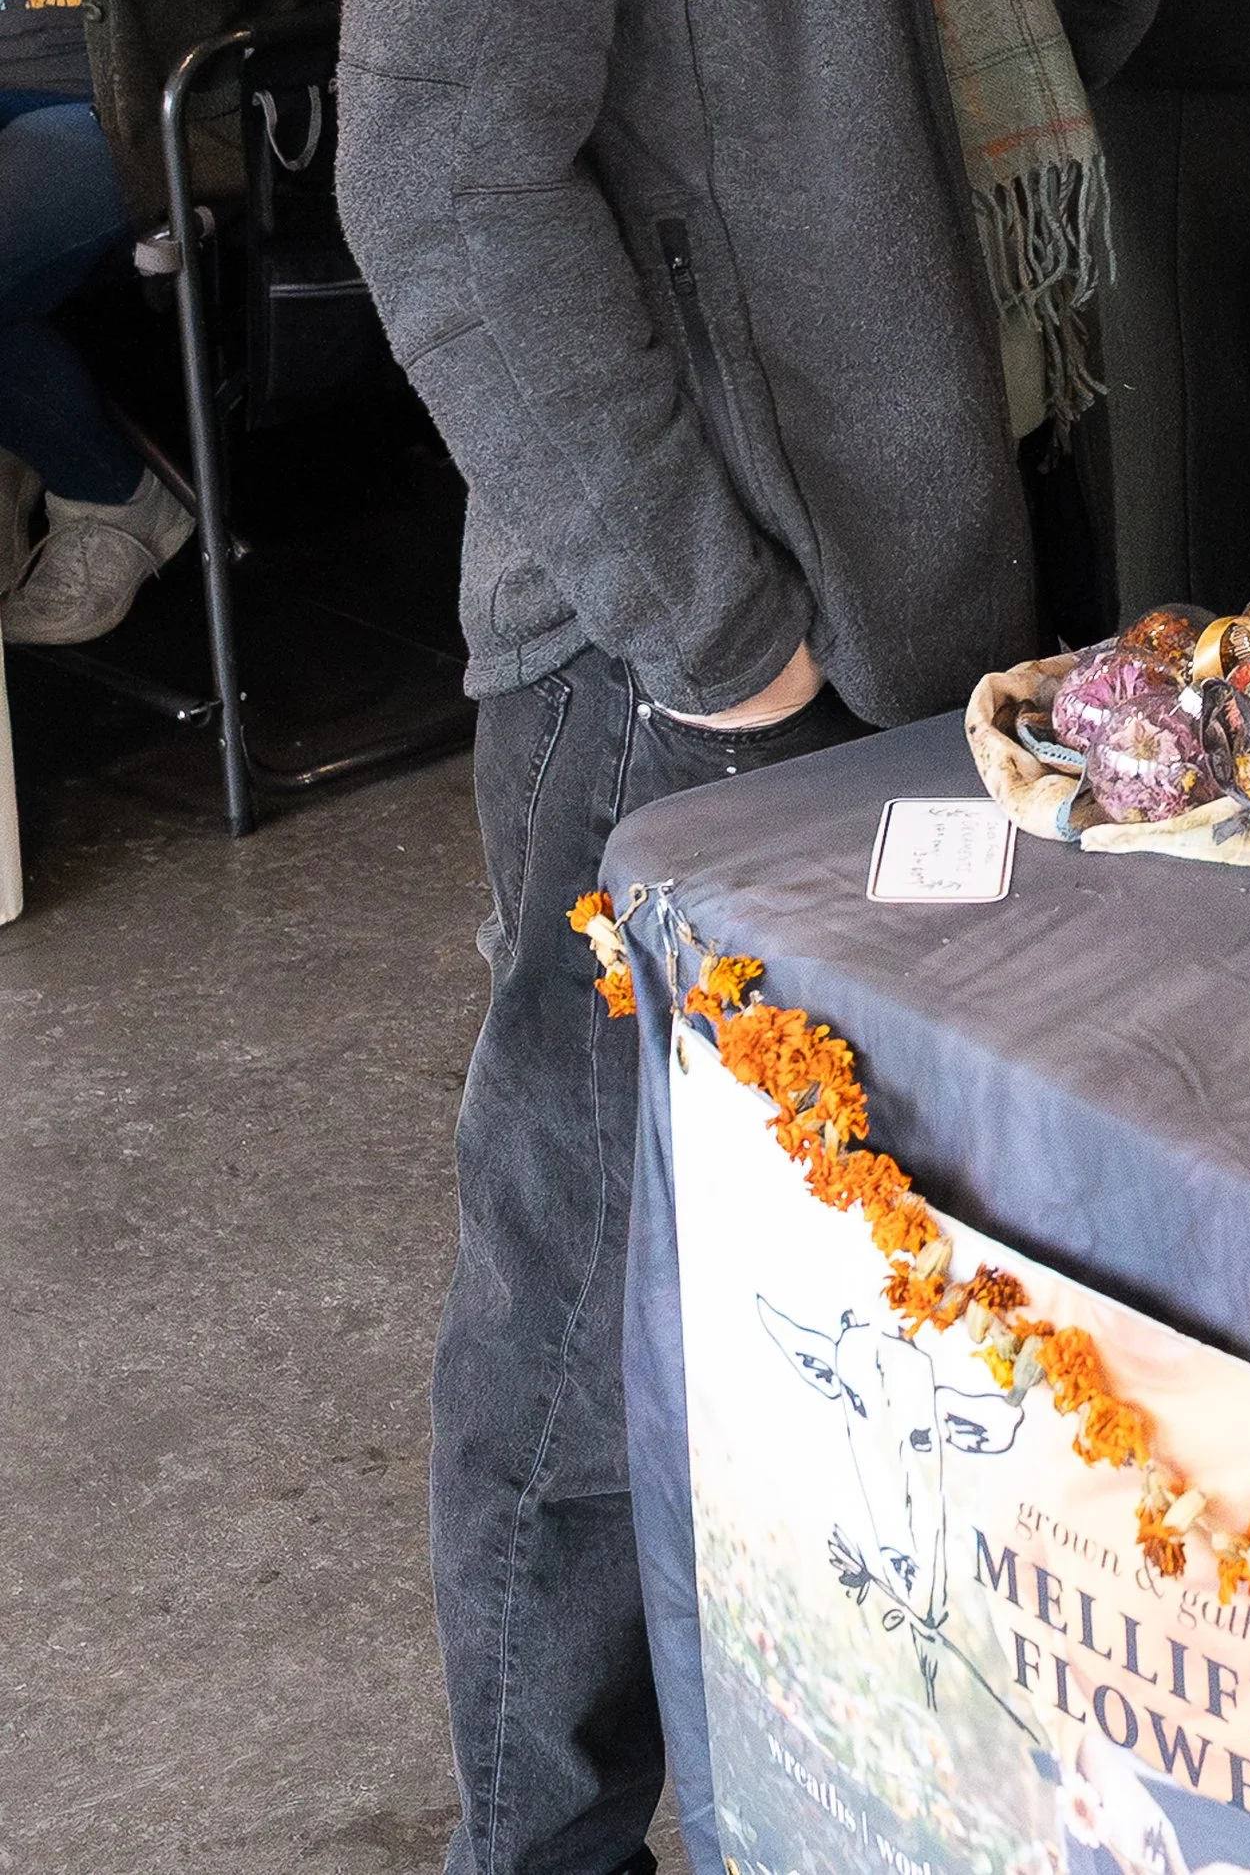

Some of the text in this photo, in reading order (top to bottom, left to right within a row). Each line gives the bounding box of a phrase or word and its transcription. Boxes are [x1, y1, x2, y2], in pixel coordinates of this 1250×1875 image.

[1015, 1502, 1120, 1577] grown
[1135, 1555, 1165, 1599] &
[768, 1732, 857, 1833] wreaths
